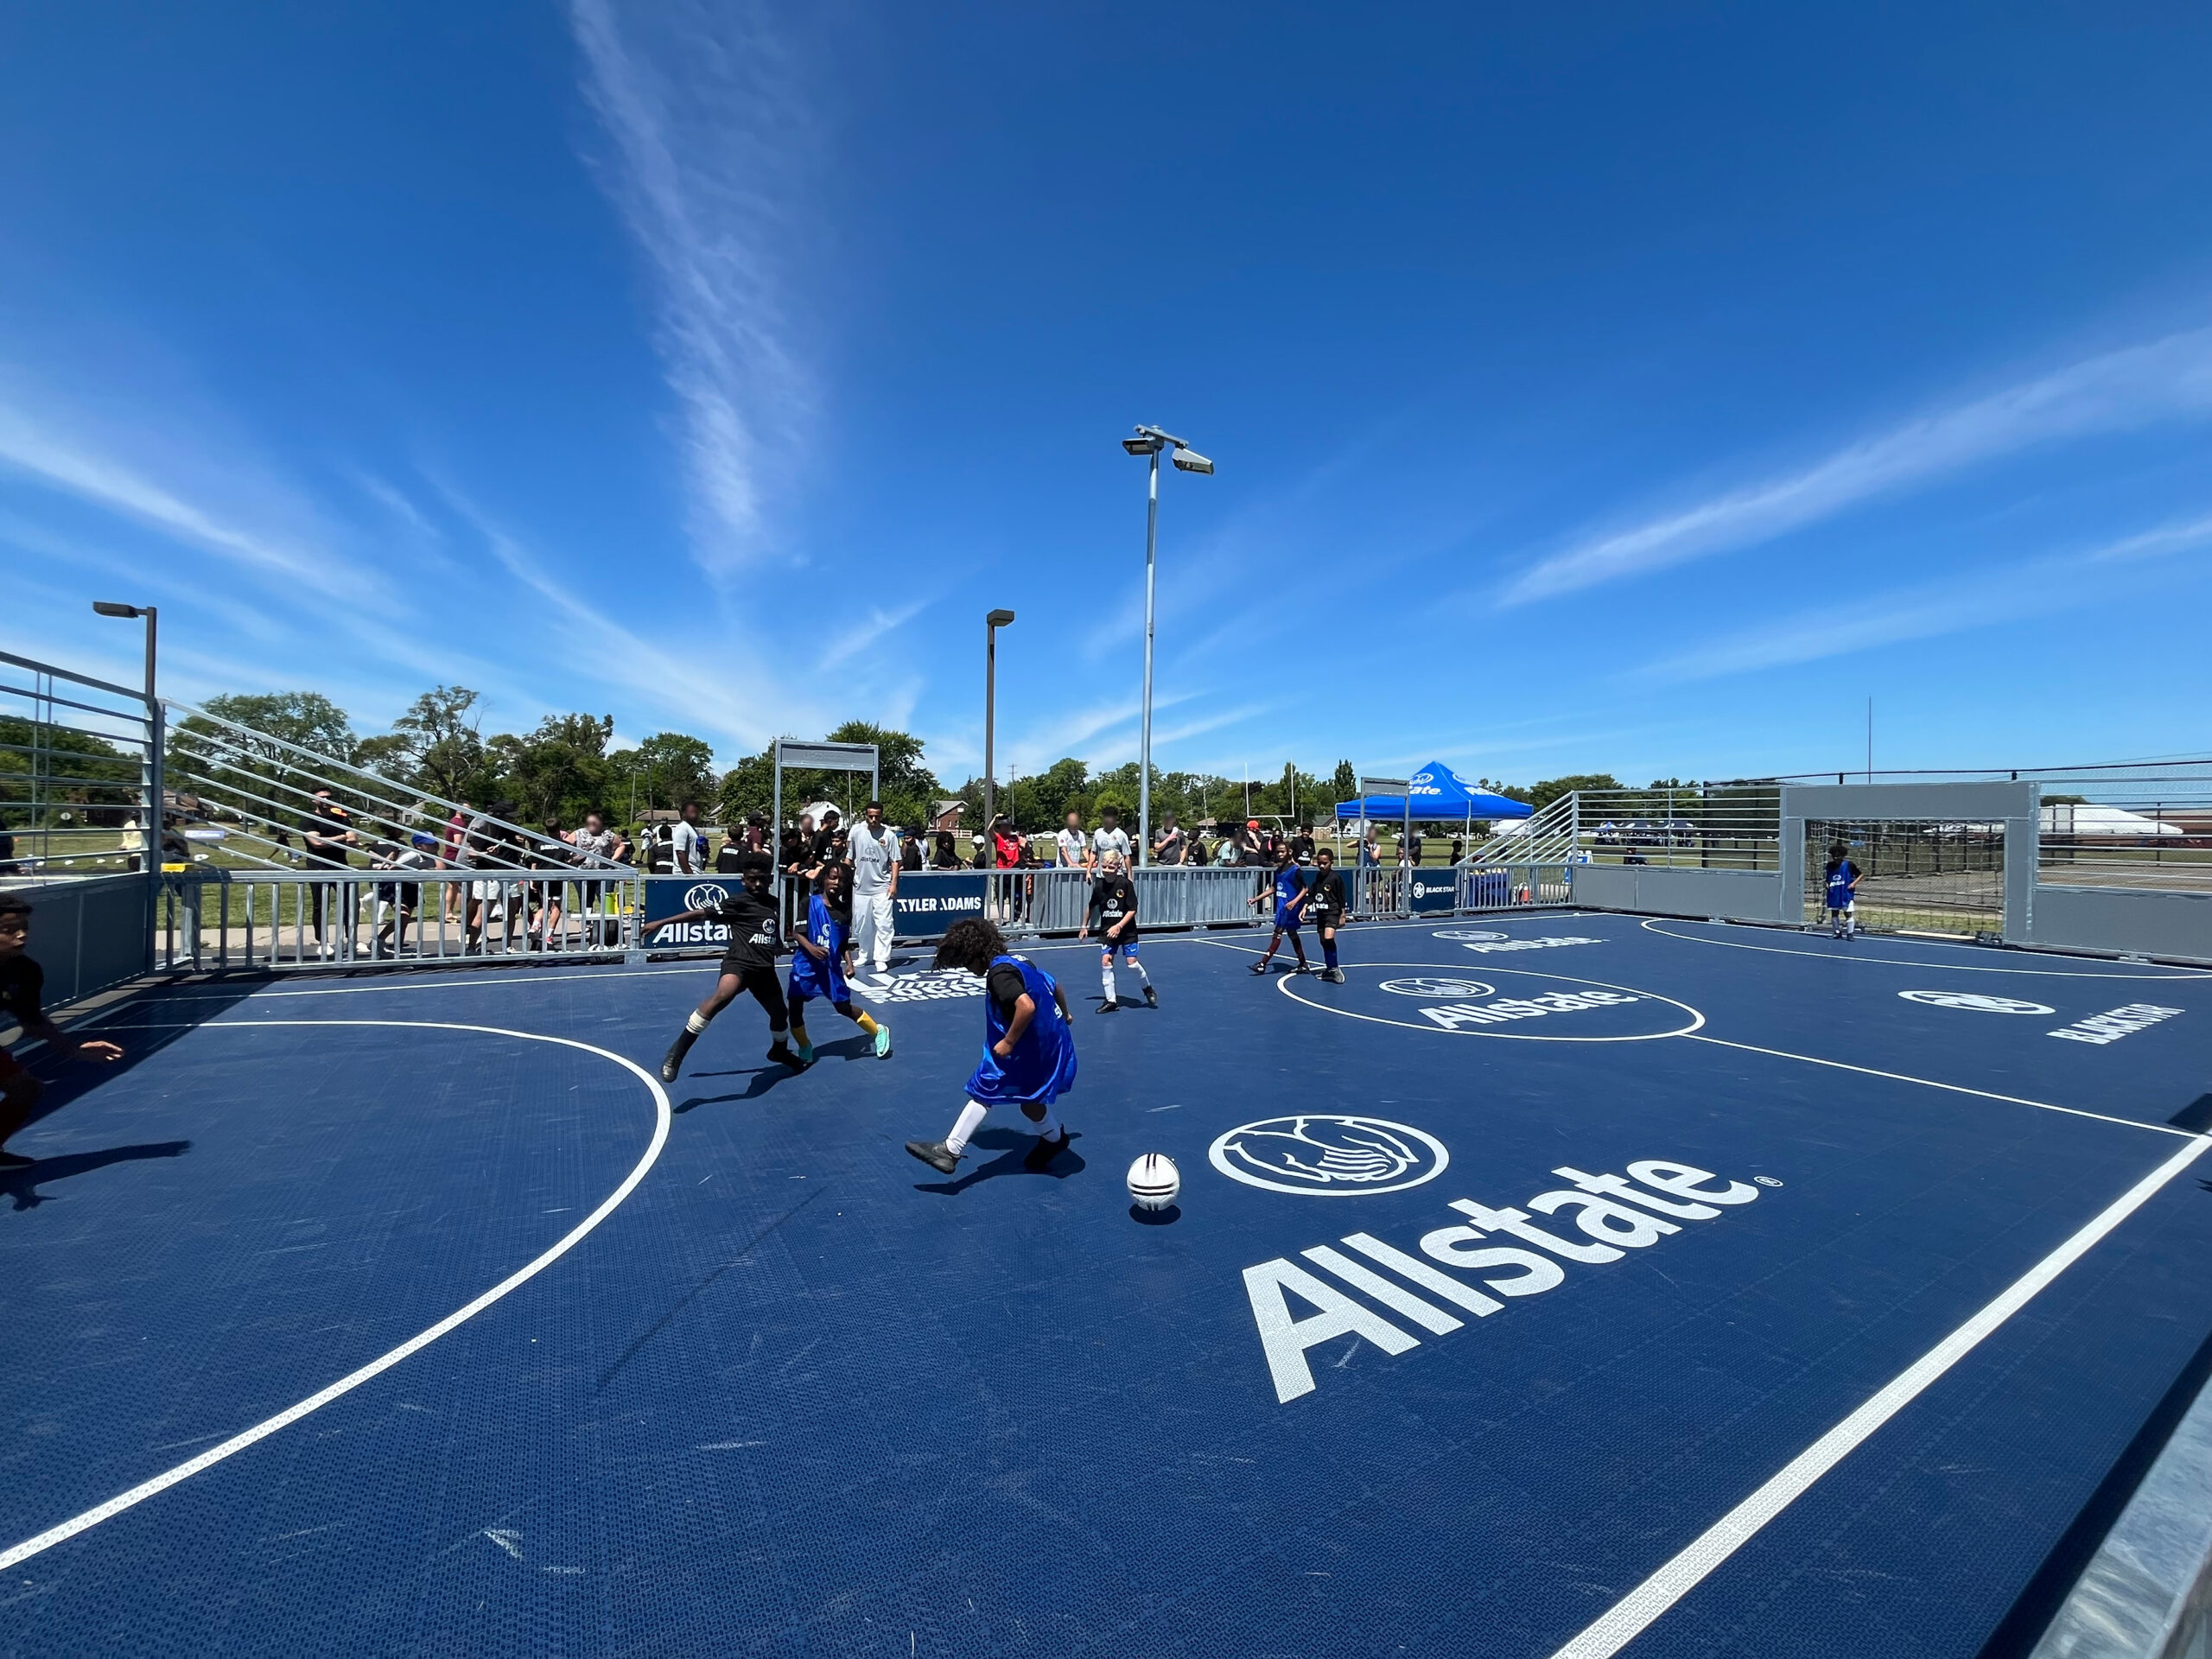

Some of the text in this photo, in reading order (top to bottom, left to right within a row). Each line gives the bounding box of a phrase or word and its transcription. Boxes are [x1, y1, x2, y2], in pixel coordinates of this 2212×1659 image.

[897, 897, 982, 912] TYLER ADAMS
[652, 920, 733, 944] Allsta
[870, 989, 987, 1004] FOUNDA
[1418, 991, 1639, 1029] Allstate
[1242, 1160, 1759, 1404] Allstate
